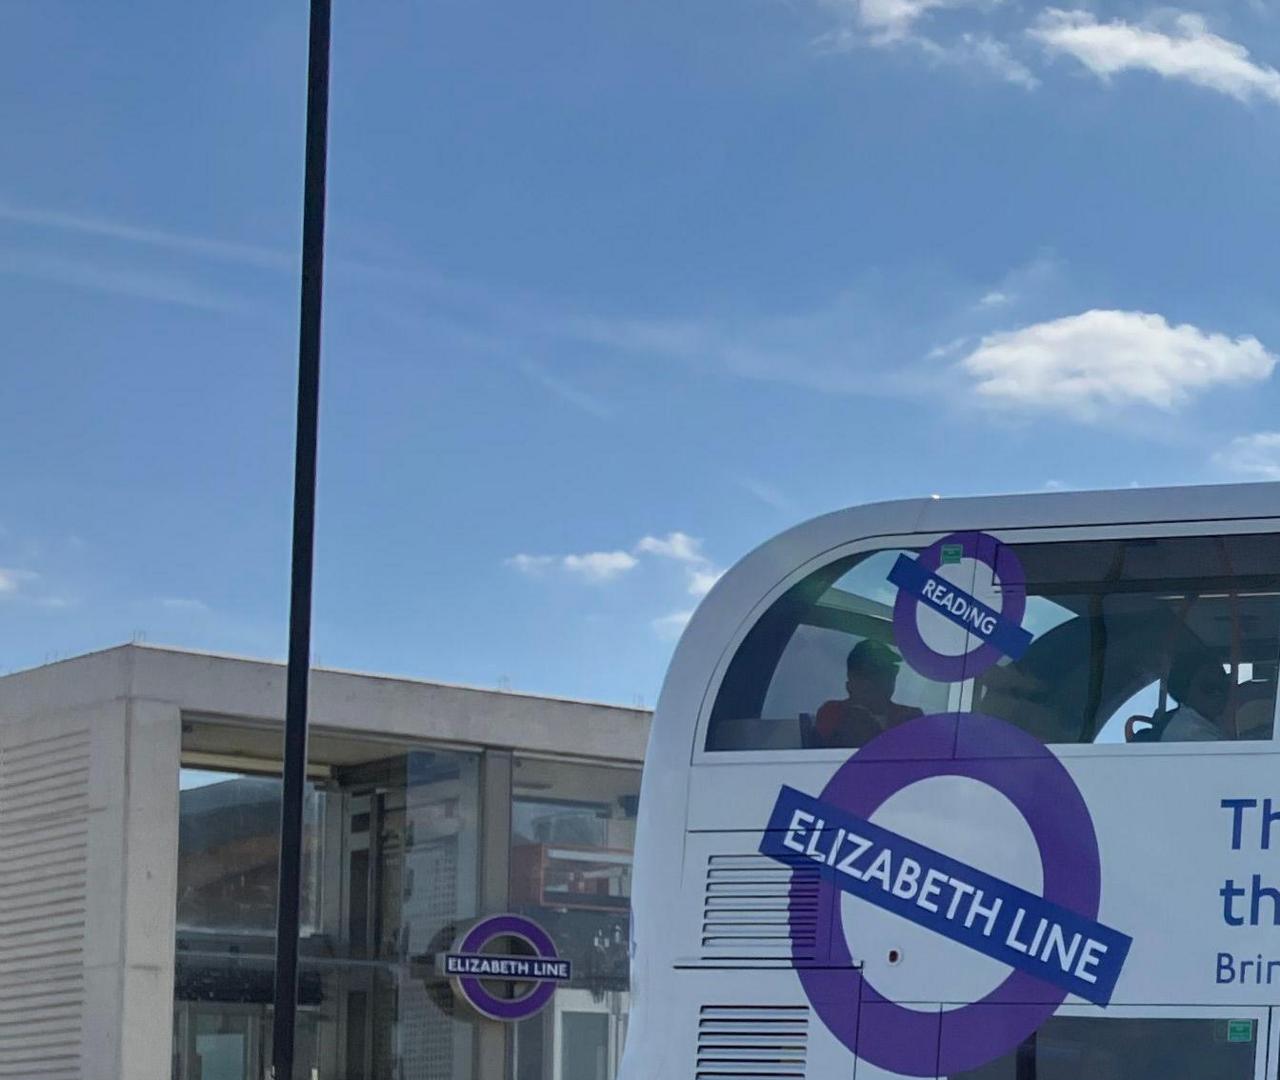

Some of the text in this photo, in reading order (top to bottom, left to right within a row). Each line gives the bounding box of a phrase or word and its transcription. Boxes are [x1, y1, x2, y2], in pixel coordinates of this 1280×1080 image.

[923, 579, 996, 636] READING
[783, 808, 1107, 983] ELIZABETH LINE
[448, 957, 567, 977] ELIZABETH LINE
